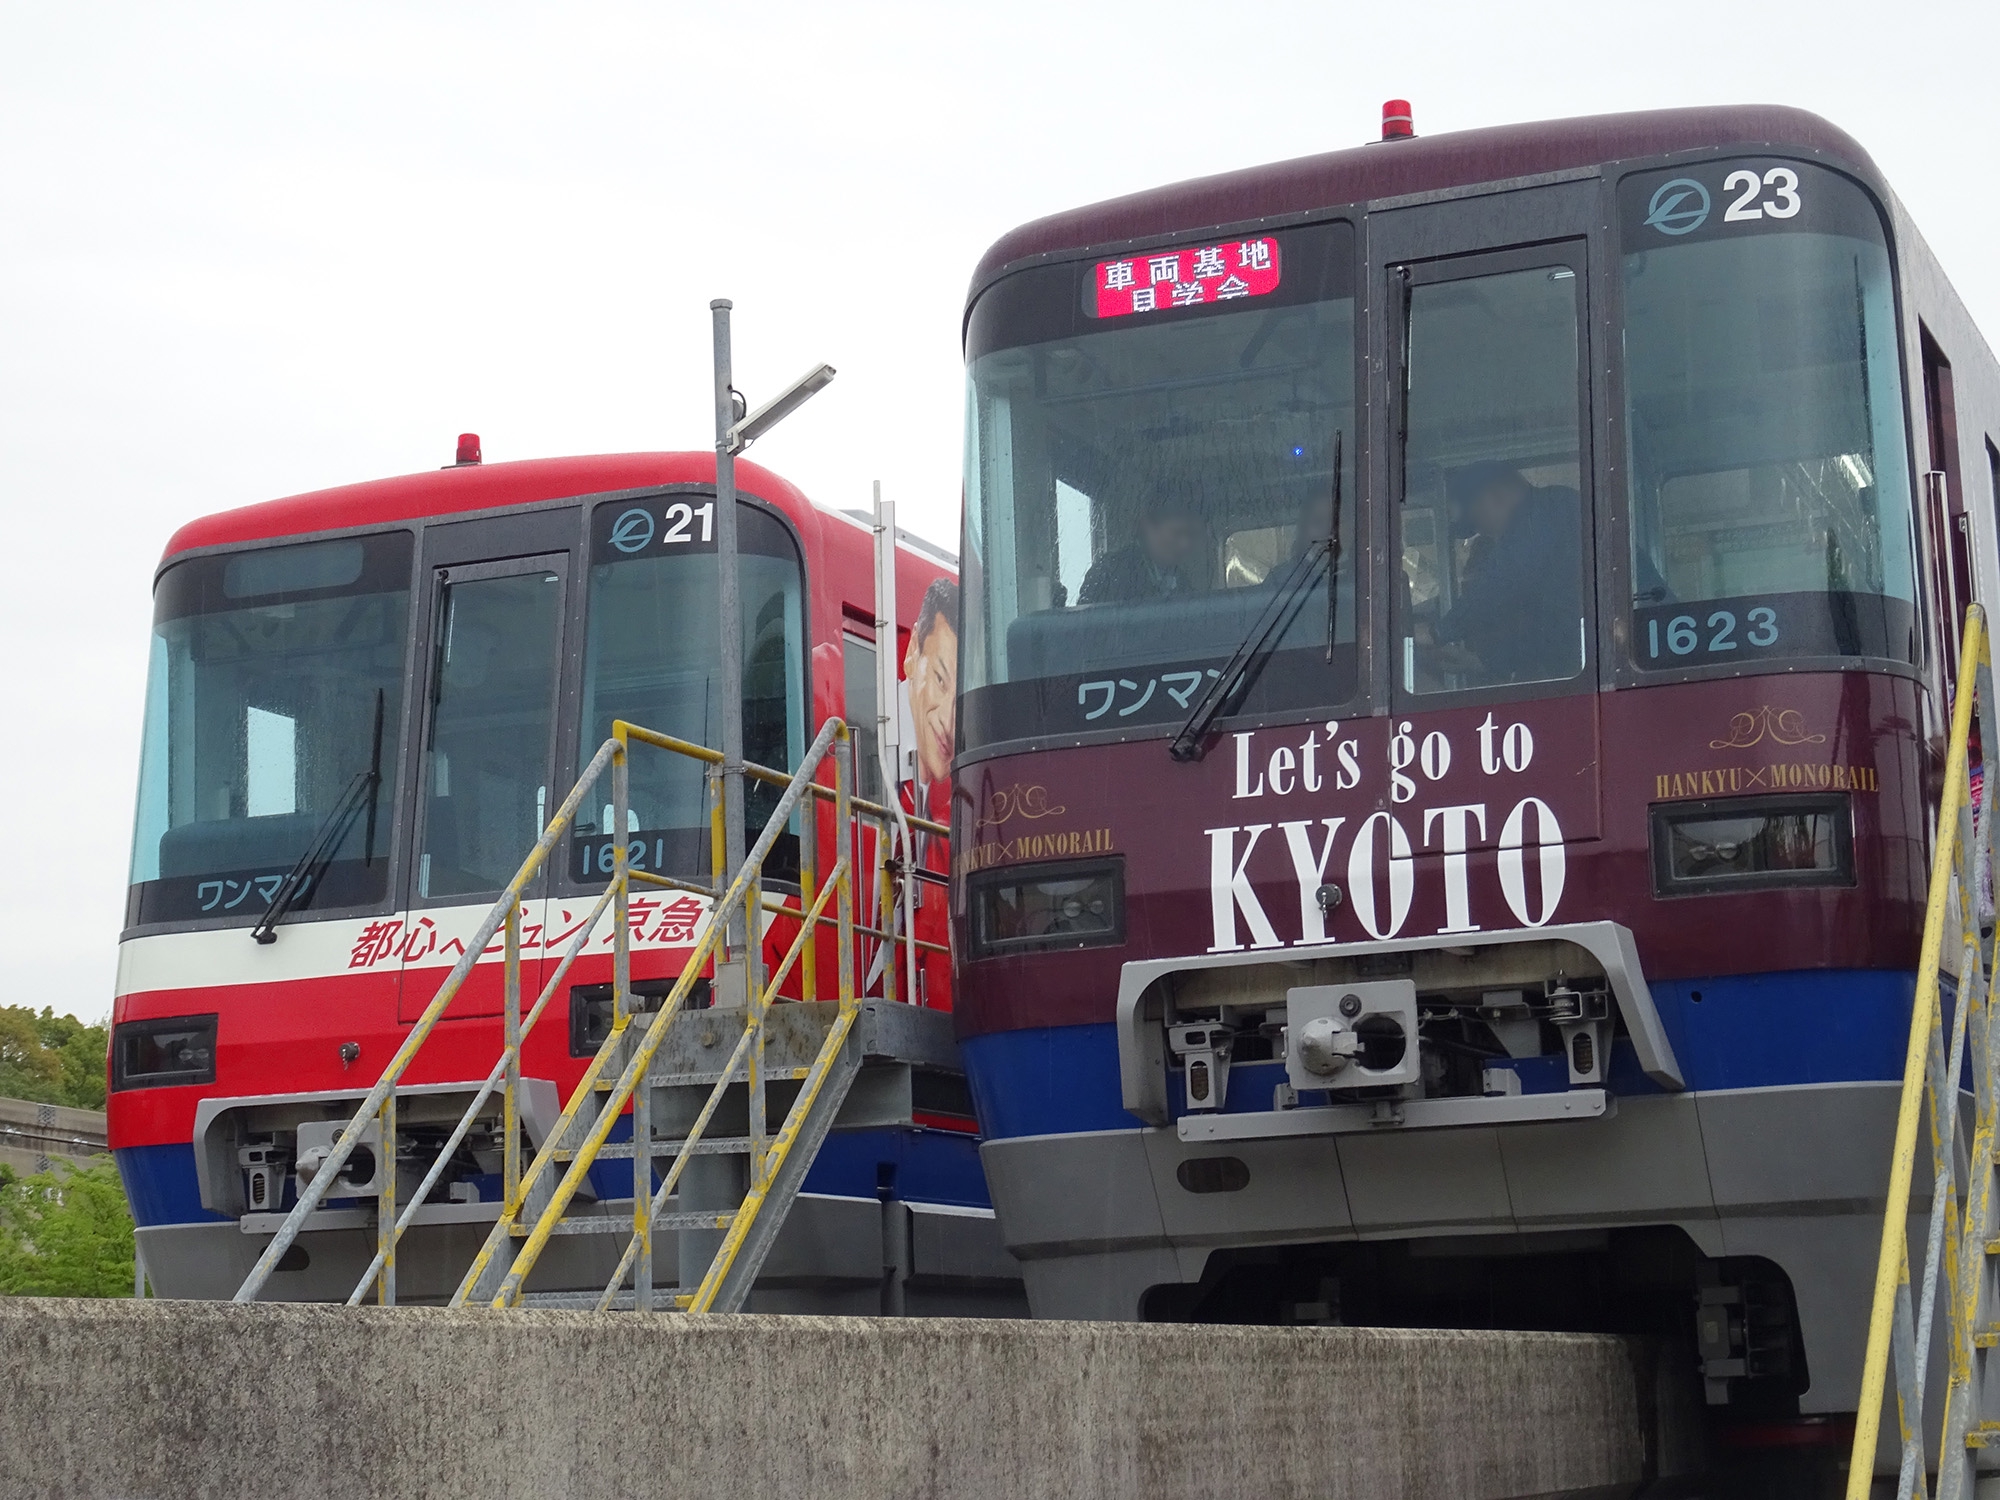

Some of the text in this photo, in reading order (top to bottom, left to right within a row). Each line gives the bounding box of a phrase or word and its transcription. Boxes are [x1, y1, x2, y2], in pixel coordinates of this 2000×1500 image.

[1723, 167, 1801, 222] 23
[1104, 240, 1271, 290] 車両基地
[663, 502, 714, 543] 21
[1648, 607, 1779, 658] 1623
[1232, 712, 1534, 803] Let's go to
[582, 838, 664, 875] 1621
[1203, 797, 1566, 953] KYOTO
[198, 873, 312, 911] ワンマン
